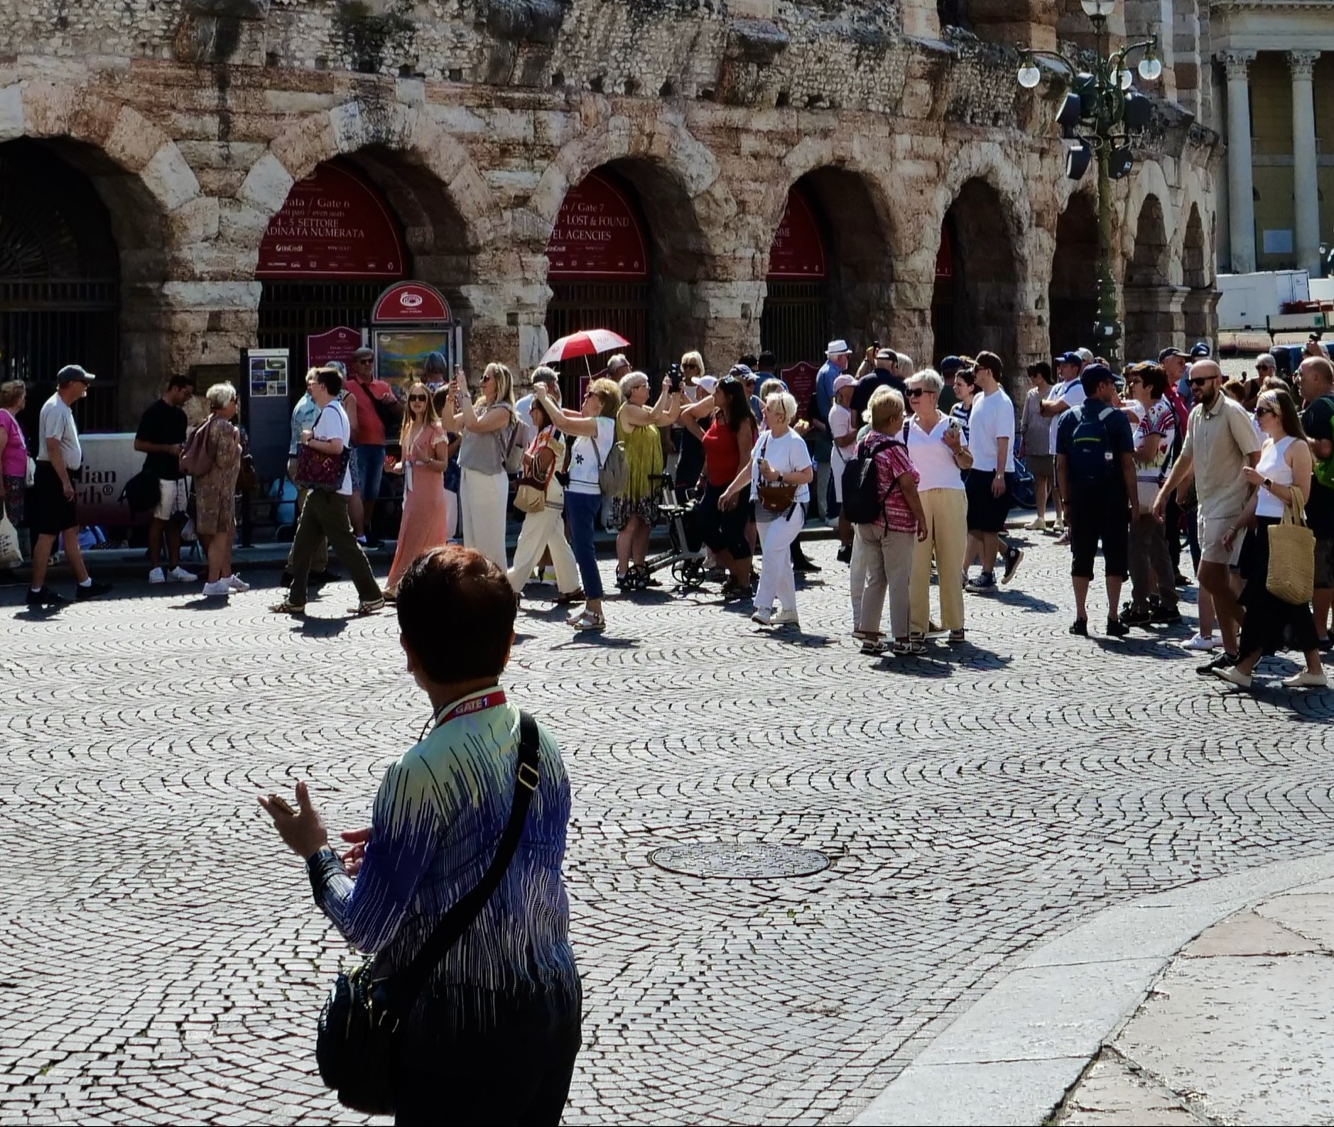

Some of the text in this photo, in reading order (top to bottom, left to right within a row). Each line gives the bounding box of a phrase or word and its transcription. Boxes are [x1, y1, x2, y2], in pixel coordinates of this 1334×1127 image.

[317, 198, 342, 208] Gate
[344, 200, 350, 209] 6
[578, 203, 597, 212] Gate
[599, 204, 605, 212] 7
[289, 218, 295, 226] 5
[298, 218, 339, 228] SETTORE
[567, 215, 588, 226] LOST
[590, 216, 597, 226] &
[599, 216, 630, 227] FOUND
[266, 226, 365, 238] ADINATA NUMERATA
[566, 229, 612, 241] AGENCIES
[78, 465, 116, 484] lian
[75, 484, 114, 504] rth®
